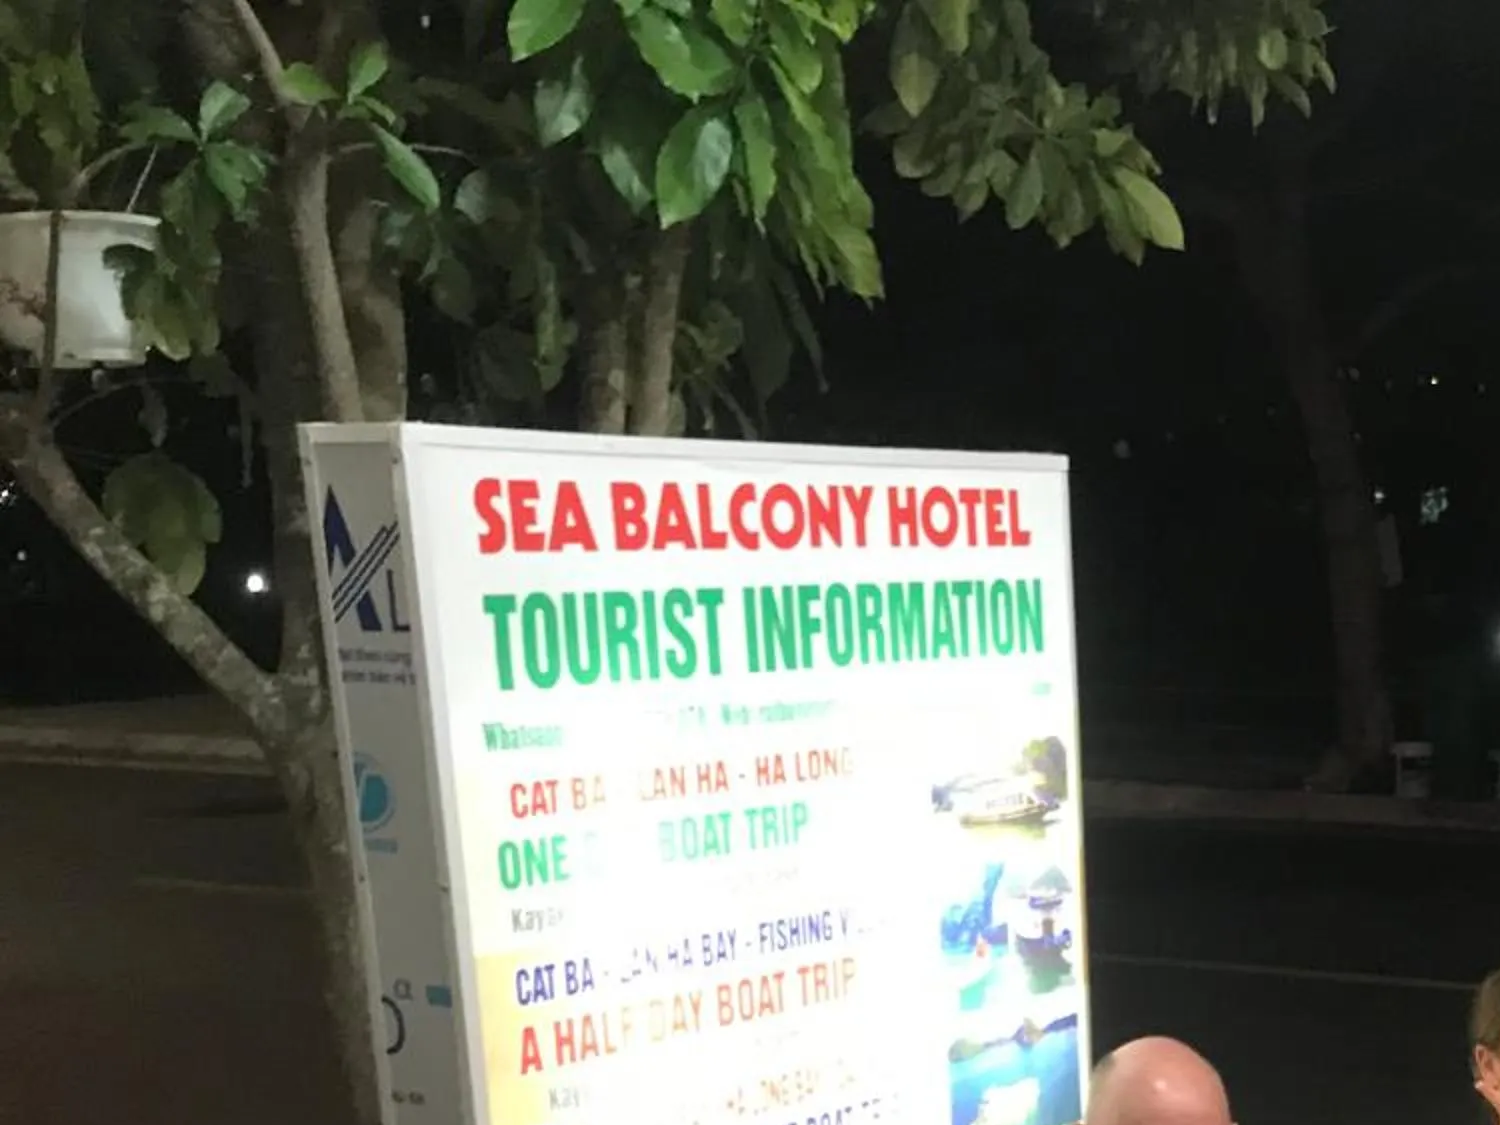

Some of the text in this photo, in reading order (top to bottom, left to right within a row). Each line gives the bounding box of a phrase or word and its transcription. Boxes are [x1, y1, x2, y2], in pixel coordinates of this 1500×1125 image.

[474, 477, 1031, 554] SEA BALCONY HOTEL
[483, 577, 1045, 690] TOURIST INFORMATION
[510, 778, 559, 819] CAT
[571, 774, 606, 811] BA
[696, 759, 729, 795] HA
[755, 752, 787, 787] HA
[794, 744, 854, 782] LONG
[497, 834, 571, 891] ONE
[658, 808, 733, 863] BOAT
[743, 799, 810, 849] TRIP
[514, 963, 556, 1006] CAT
[564, 957, 597, 997] BA
[701, 927, 738, 968] BAY
[758, 907, 834, 955] FISHING
[519, 956, 858, 1076] A HALF DAY BOAT TRIP
